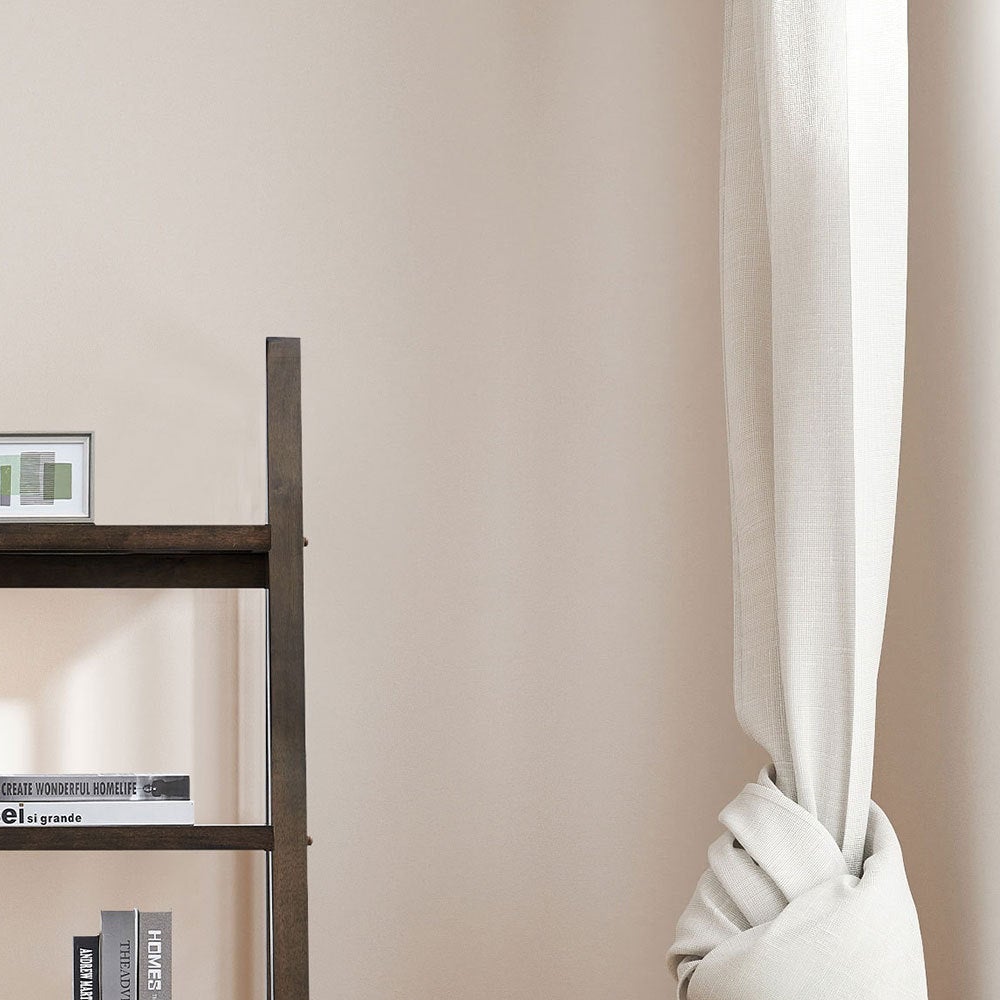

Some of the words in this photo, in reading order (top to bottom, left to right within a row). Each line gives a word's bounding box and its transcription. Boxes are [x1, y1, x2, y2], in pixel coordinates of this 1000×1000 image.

[1, 782, 33, 796] CREATE
[35, 781, 91, 796] WONDERFUL
[93, 781, 137, 795] HOMELIFE
[27, 813, 38, 823] si
[40, 813, 82, 826] grande
[80, 948, 93, 979] ANDREW
[147, 930, 162, 991] HOMES
